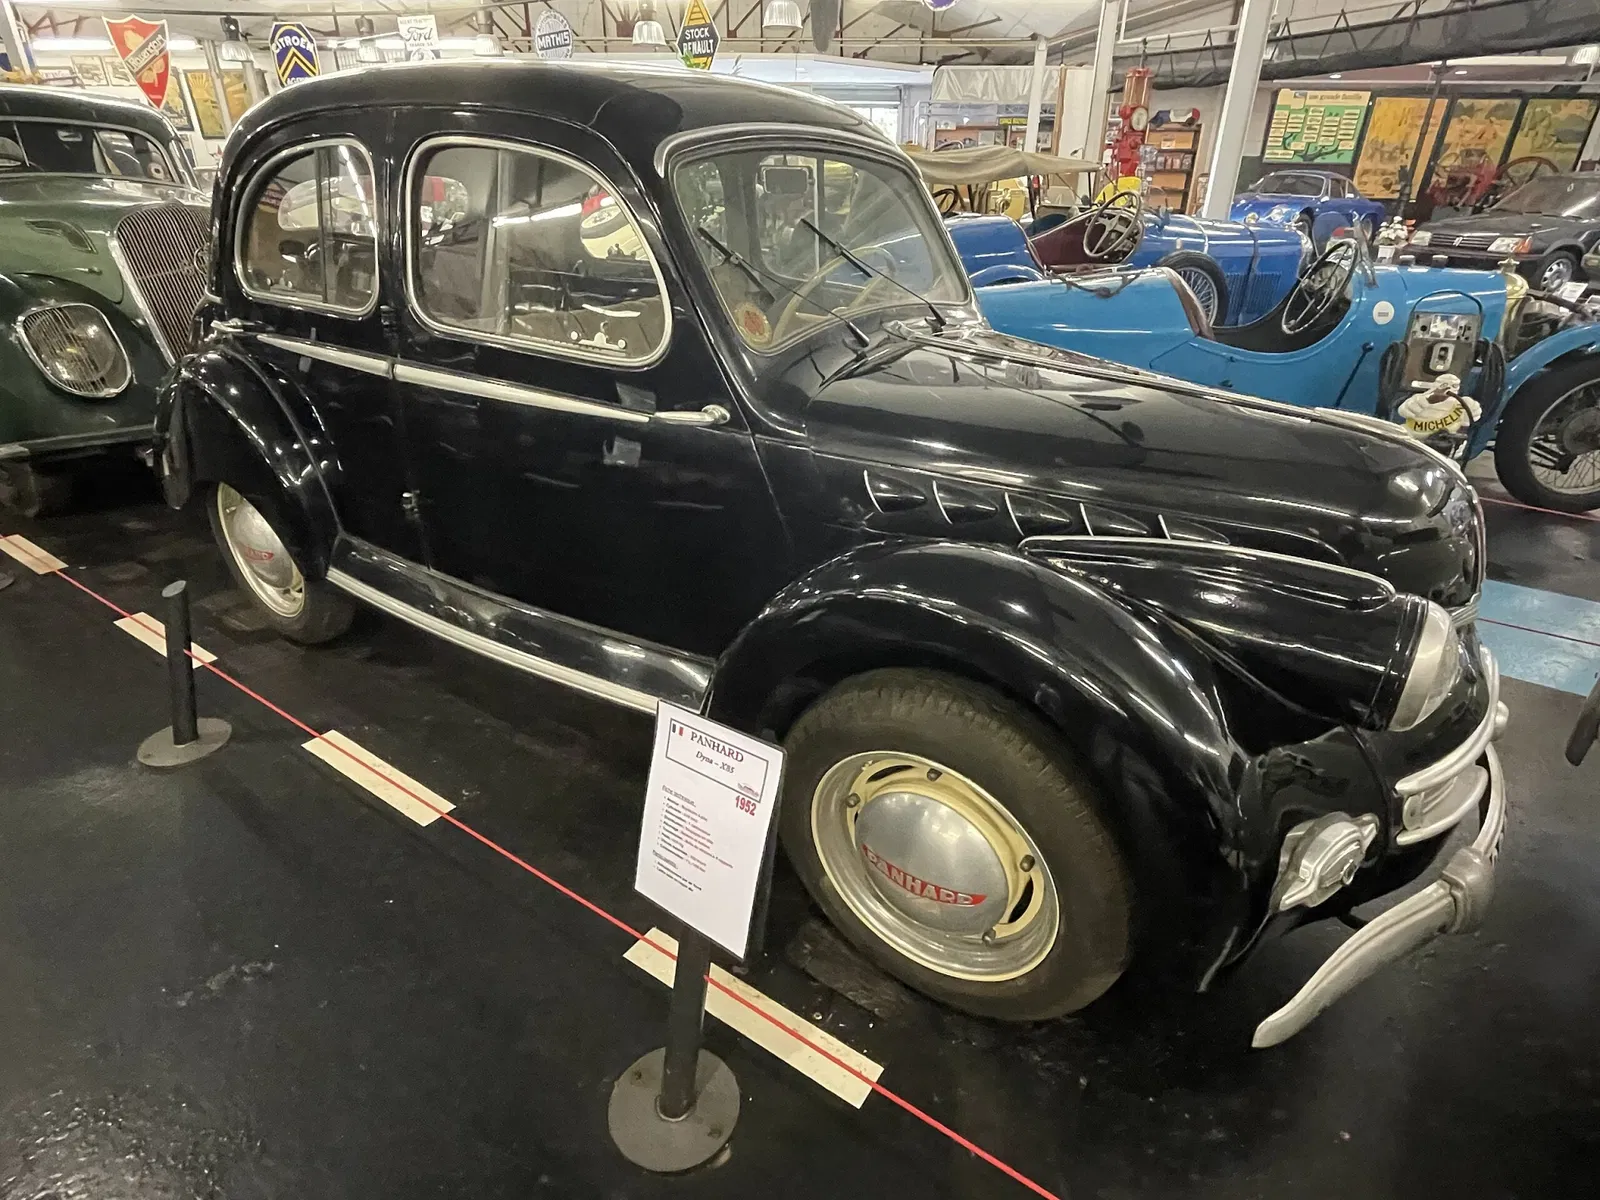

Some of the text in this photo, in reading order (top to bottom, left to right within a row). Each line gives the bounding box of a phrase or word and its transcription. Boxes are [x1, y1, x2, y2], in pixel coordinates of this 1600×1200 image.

[404, 26, 433, 42] Ford
[537, 31, 570, 49] MATHIS
[684, 27, 710, 40] STOCK
[125, 33, 167, 74] Rosengart
[682, 39, 714, 57] RENAULT
[1413, 403, 1465, 432] MICHELIN
[689, 730, 744, 763] PANHARD
[695, 750, 713, 765] Dyna
[735, 795, 757, 817] 1952
[866, 850, 974, 905] PANHARD
